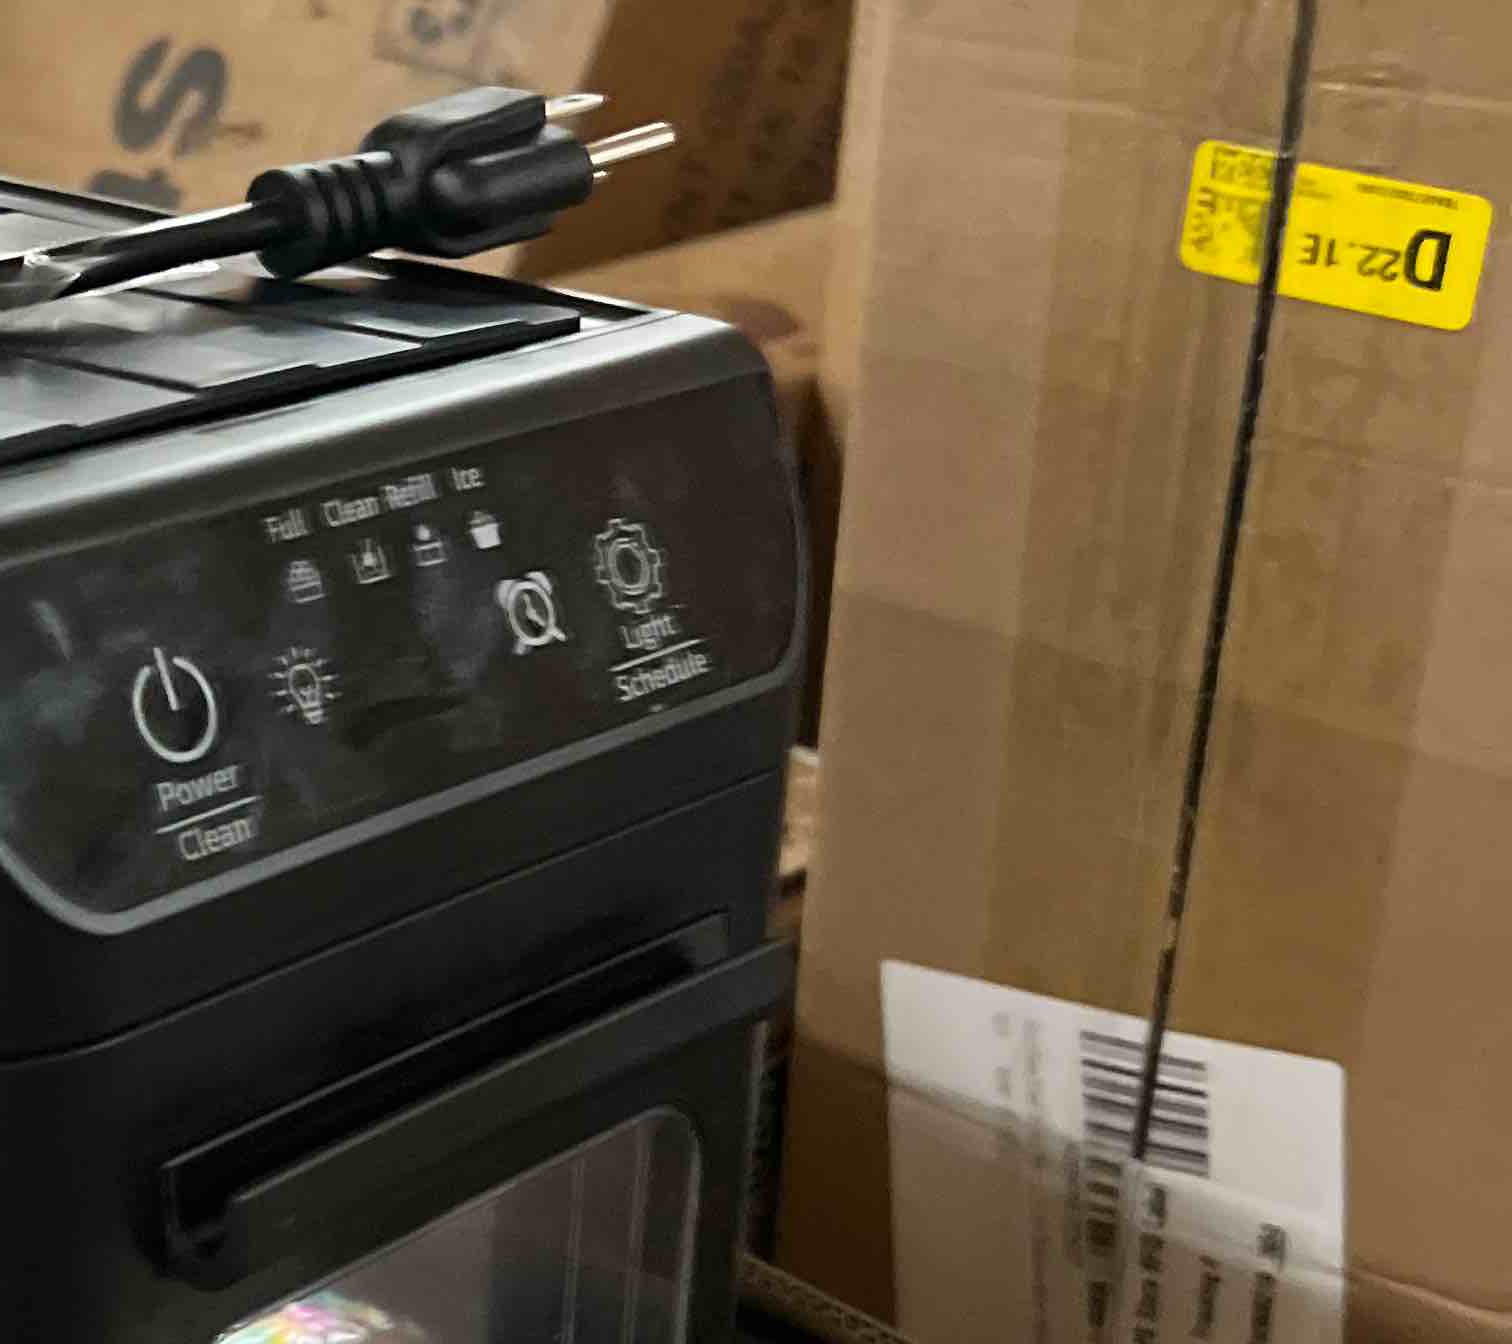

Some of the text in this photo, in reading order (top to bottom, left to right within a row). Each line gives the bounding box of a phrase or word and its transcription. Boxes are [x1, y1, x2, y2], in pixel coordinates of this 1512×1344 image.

[263, 508, 309, 544] Full
[321, 496, 382, 528] Clean
[451, 466, 484, 492] Ice
[620, 616, 680, 651] Light
[615, 652, 713, 702] Schedule
[156, 763, 240, 812] Power
[178, 814, 257, 862] Clean
